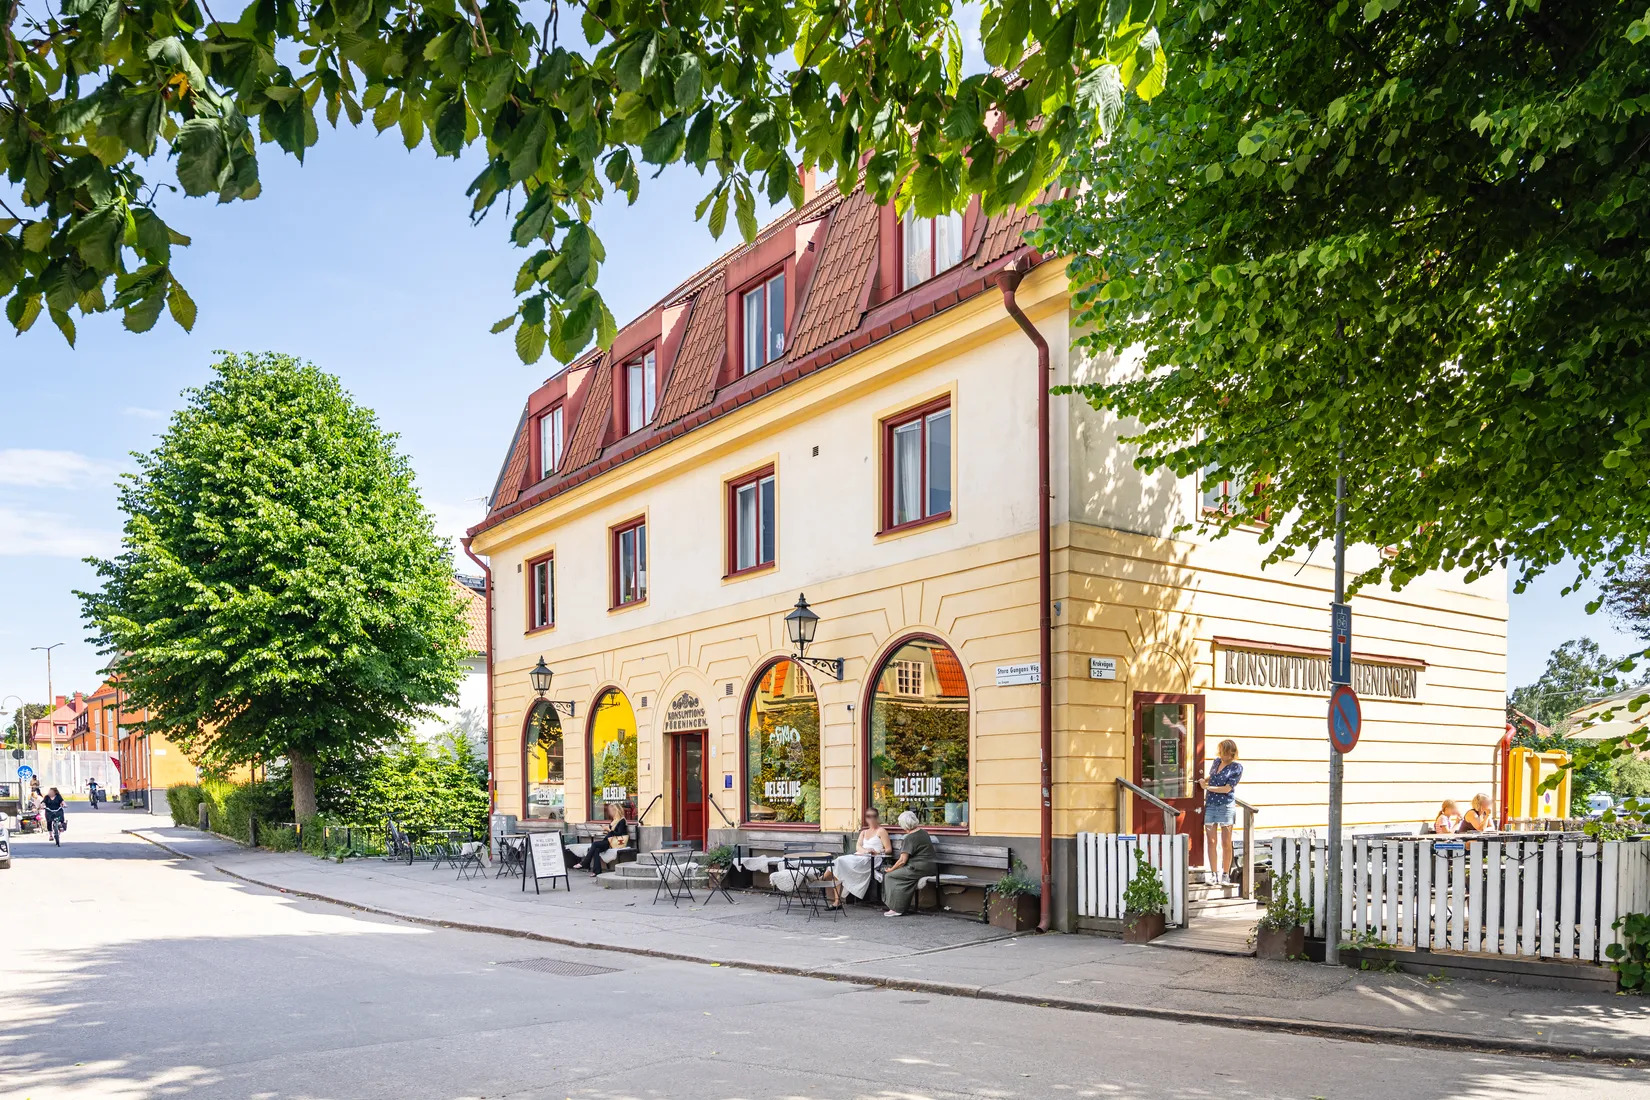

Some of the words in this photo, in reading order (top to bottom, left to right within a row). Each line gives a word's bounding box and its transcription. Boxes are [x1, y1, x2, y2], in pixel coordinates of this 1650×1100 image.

[1030, 664, 1039, 673] Väg
[1092, 660, 1114, 669] Krokvägen
[1092, 669, 1103, 677] 1-25
[1225, 649, 1417, 698] KONSUMTIONRENINGEN
[765, 780, 801, 797] DELSELIUS
[894, 777, 942, 796] DELSELIUS
